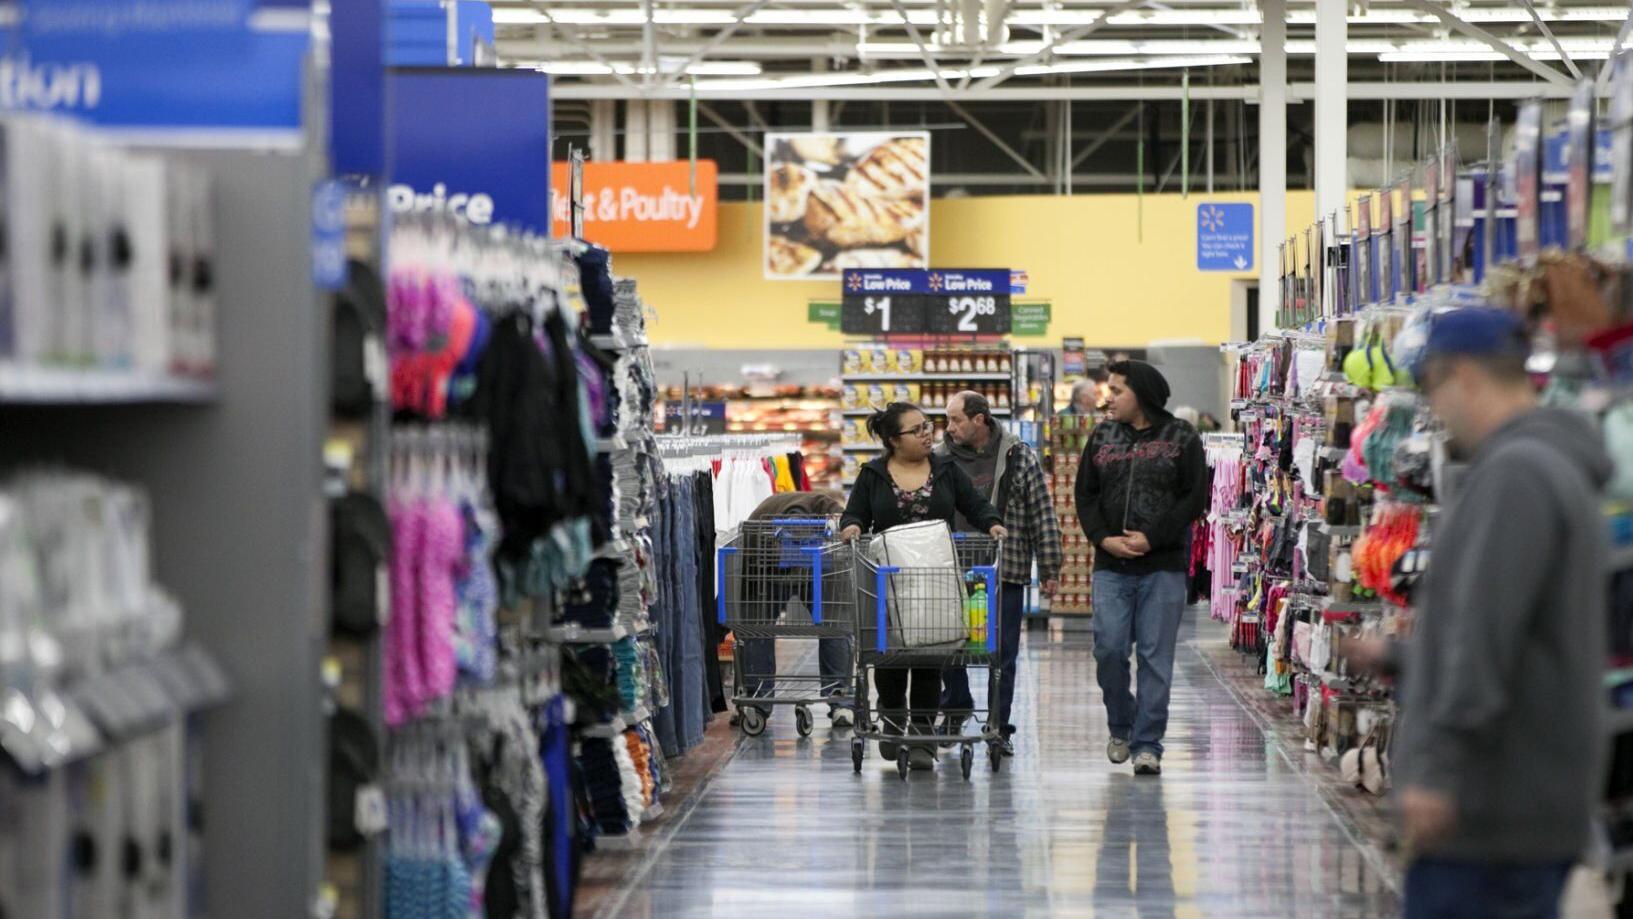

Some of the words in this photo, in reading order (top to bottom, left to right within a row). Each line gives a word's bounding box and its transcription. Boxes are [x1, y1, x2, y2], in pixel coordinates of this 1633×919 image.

[386, 182, 494, 224] Price
[598, 186, 619, 221] &
[620, 184, 703, 229] Poultry
[864, 279, 885, 290] Low
[886, 278, 911, 290] Price
[945, 279, 965, 290] Low
[966, 278, 992, 290] Price
